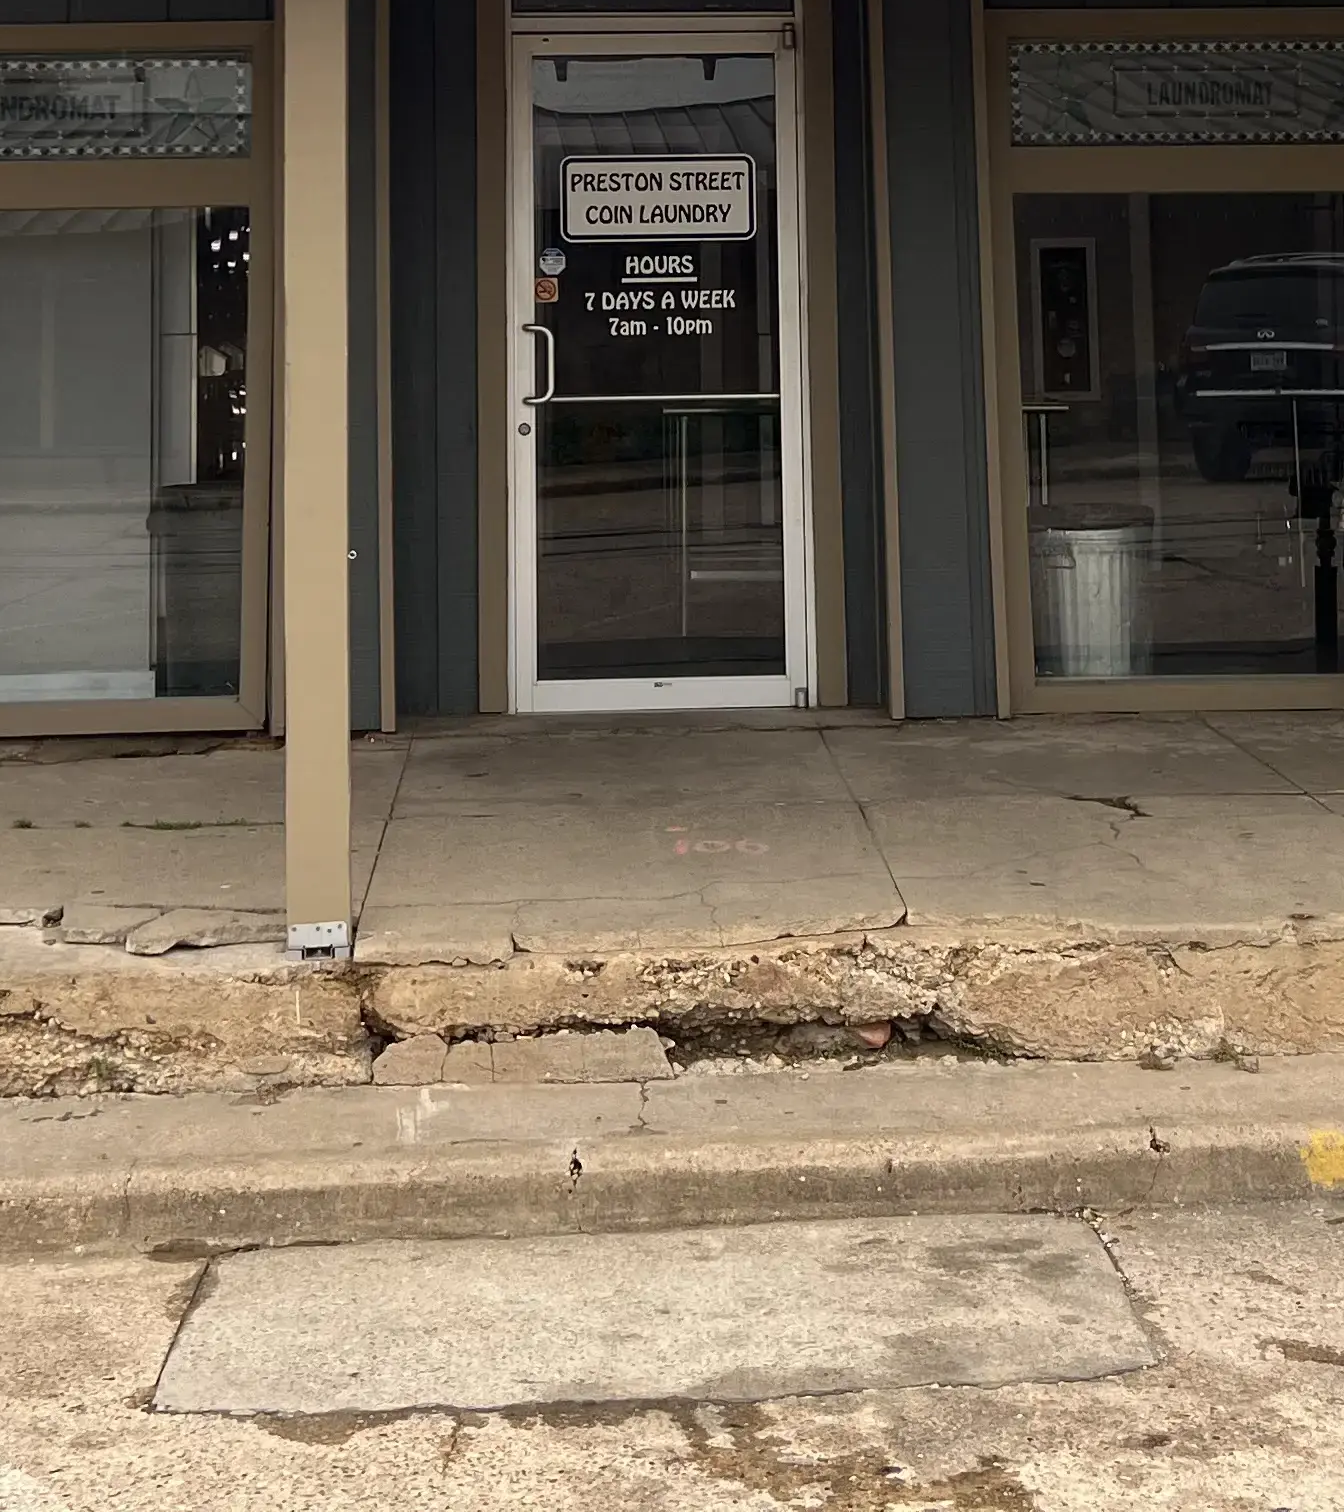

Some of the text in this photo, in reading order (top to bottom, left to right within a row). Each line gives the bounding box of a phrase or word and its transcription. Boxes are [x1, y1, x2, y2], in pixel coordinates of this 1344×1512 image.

[1146, 80, 1274, 106] LAUNDROMAT
[570, 171, 745, 193] PRESTON STREET
[585, 203, 732, 225] COIN LAUNDRY
[625, 255, 694, 275] HOURS
[584, 290, 736, 312] 7 DAYS A WEEK
[608, 317, 647, 337] 7am
[666, 316, 713, 336] 10pm
